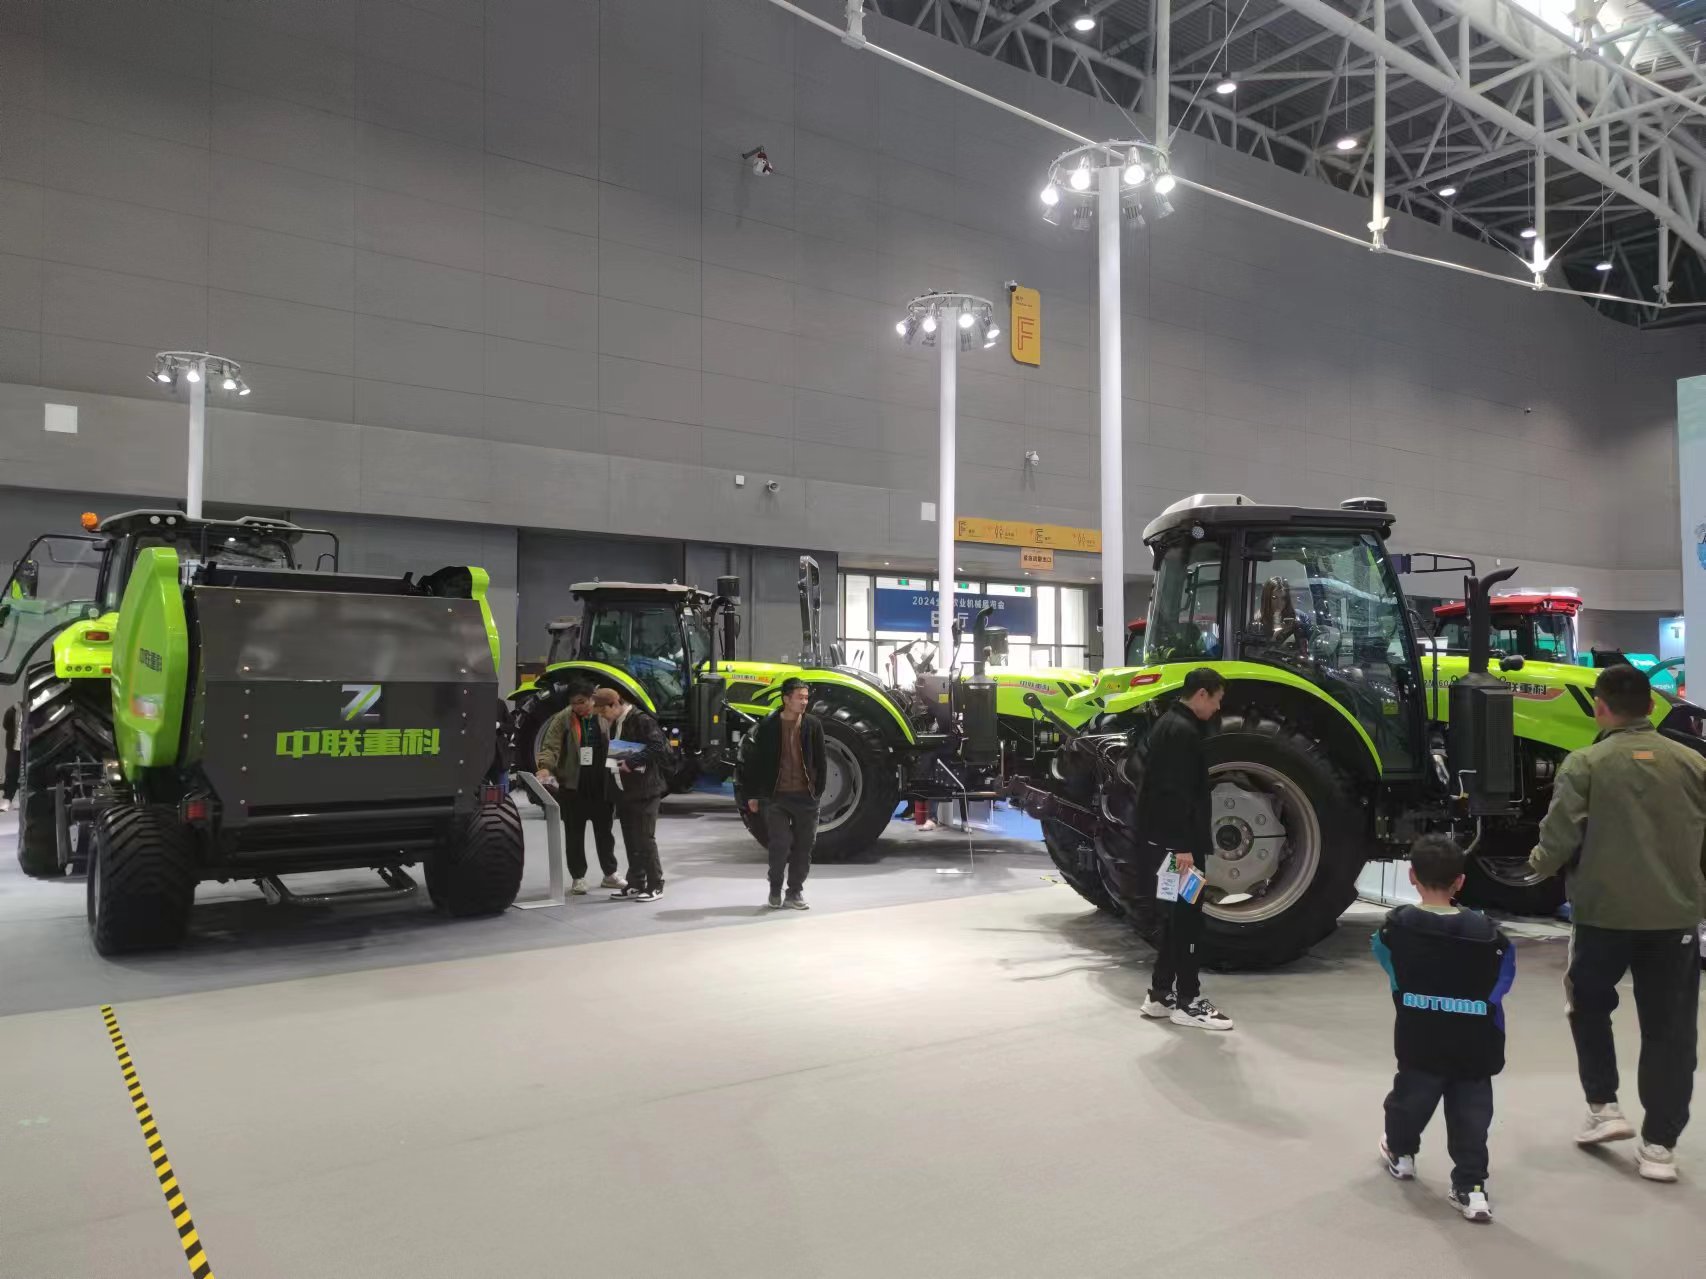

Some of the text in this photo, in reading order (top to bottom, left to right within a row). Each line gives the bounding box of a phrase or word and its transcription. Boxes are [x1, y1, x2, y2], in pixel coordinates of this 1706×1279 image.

[1018, 316, 1034, 350] F
[912, 596, 1005, 610] 2024农业机械展览会
[1505, 681, 1547, 695] 联重科
[275, 728, 441, 759] 中联重科
